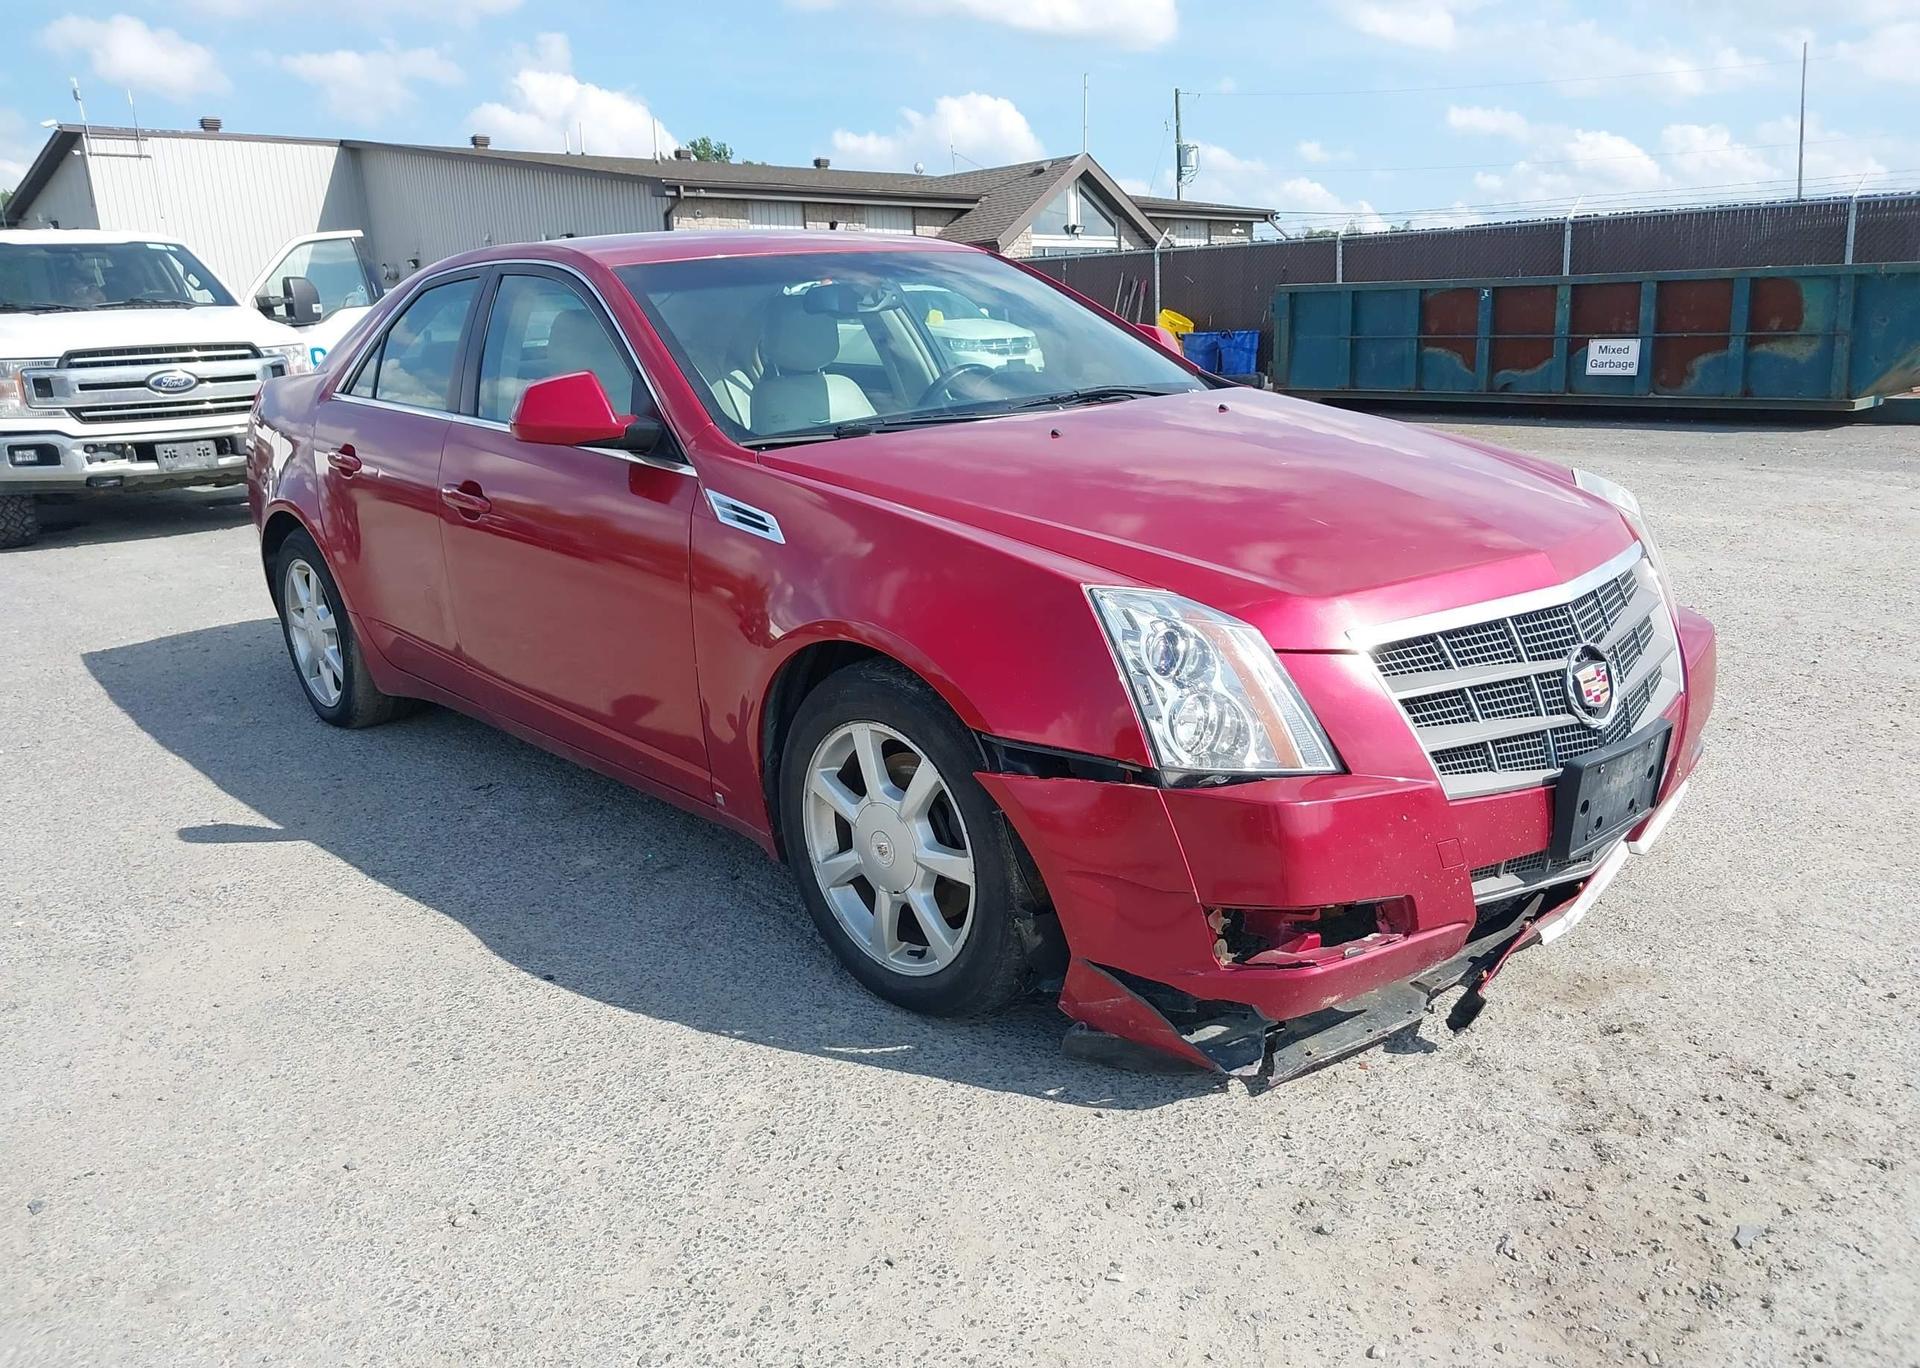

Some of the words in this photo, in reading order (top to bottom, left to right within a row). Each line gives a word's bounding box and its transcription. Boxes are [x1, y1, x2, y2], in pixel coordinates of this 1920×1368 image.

[1598, 345, 1630, 354] Mixed
[1590, 359, 1634, 370] Garbage
[161, 375, 186, 388] Ford
